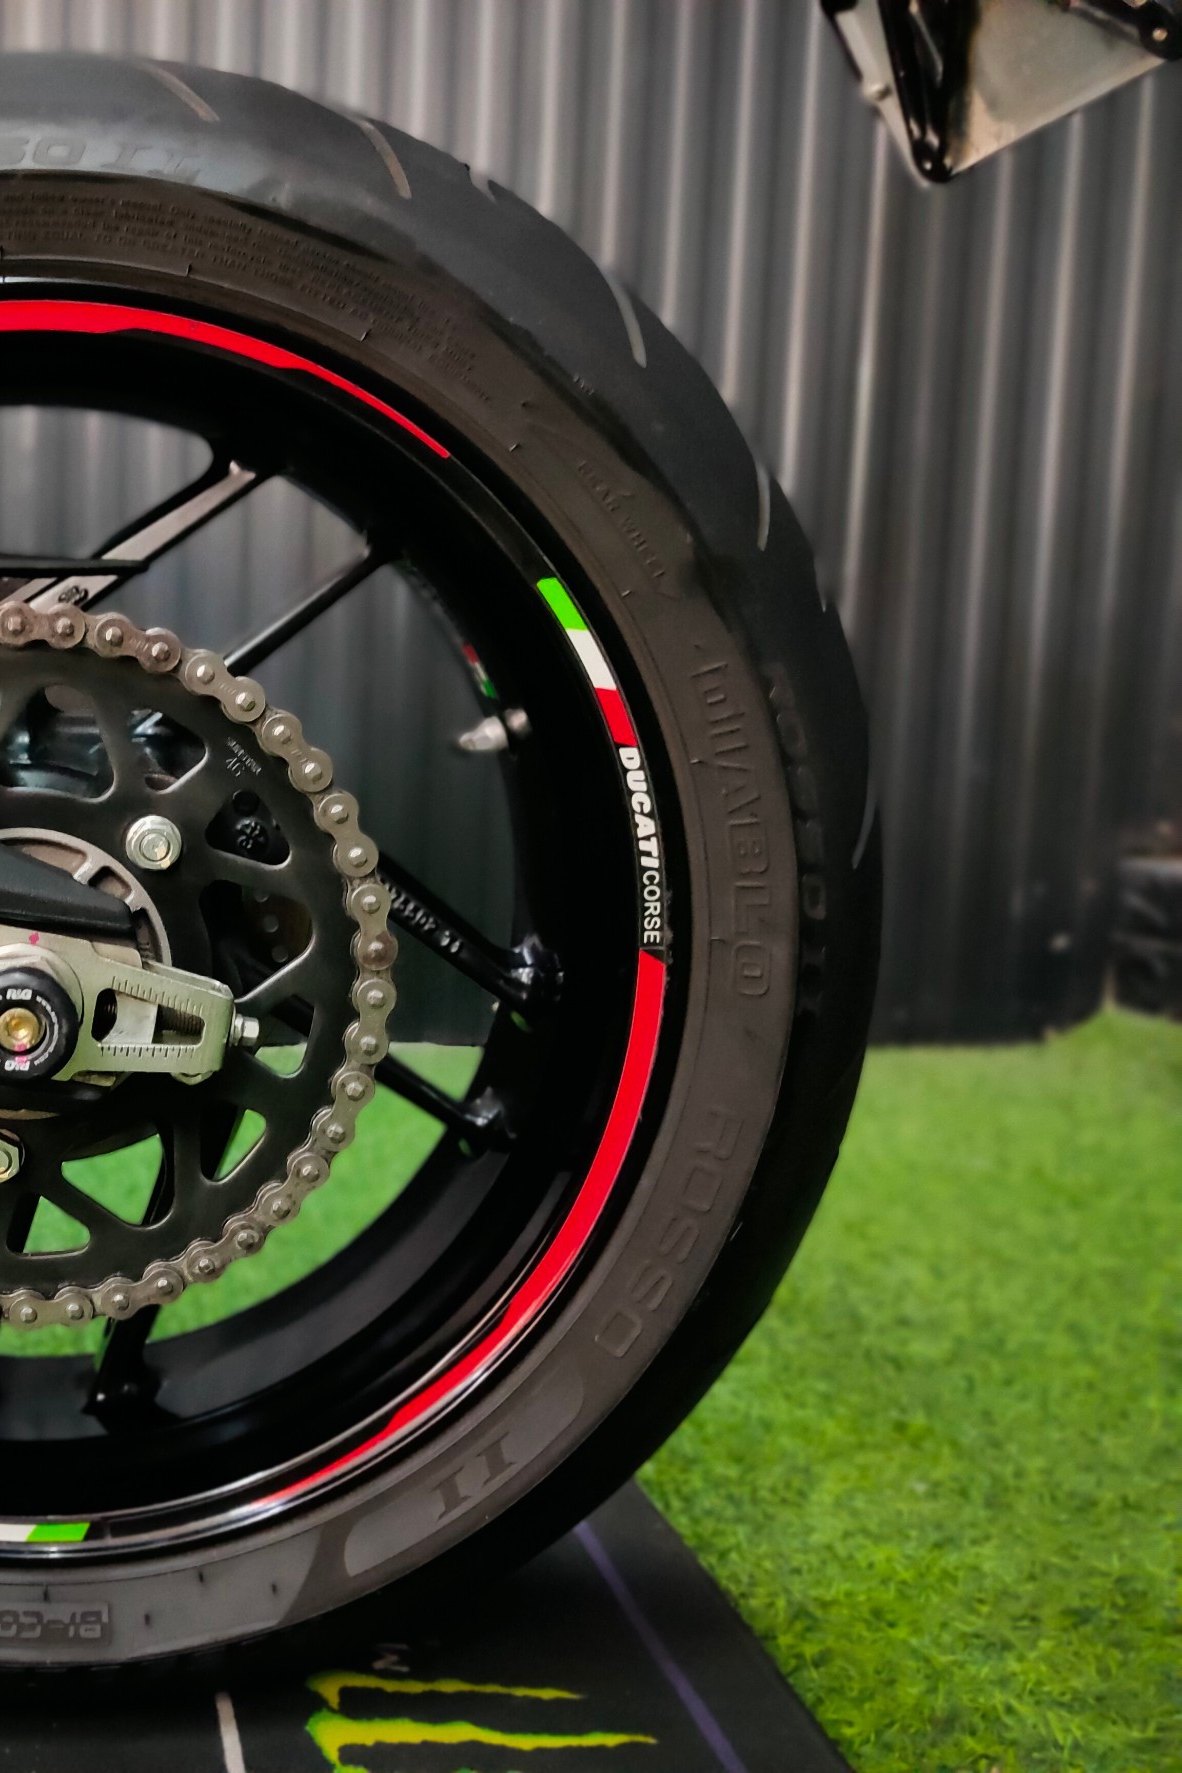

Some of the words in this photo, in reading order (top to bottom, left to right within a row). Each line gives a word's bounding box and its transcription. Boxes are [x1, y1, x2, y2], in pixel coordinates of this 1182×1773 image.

[619, 746, 660, 871] DUCATI
[642, 870, 662, 944] CORSE
[595, 1110, 745, 1358] ROSSO
